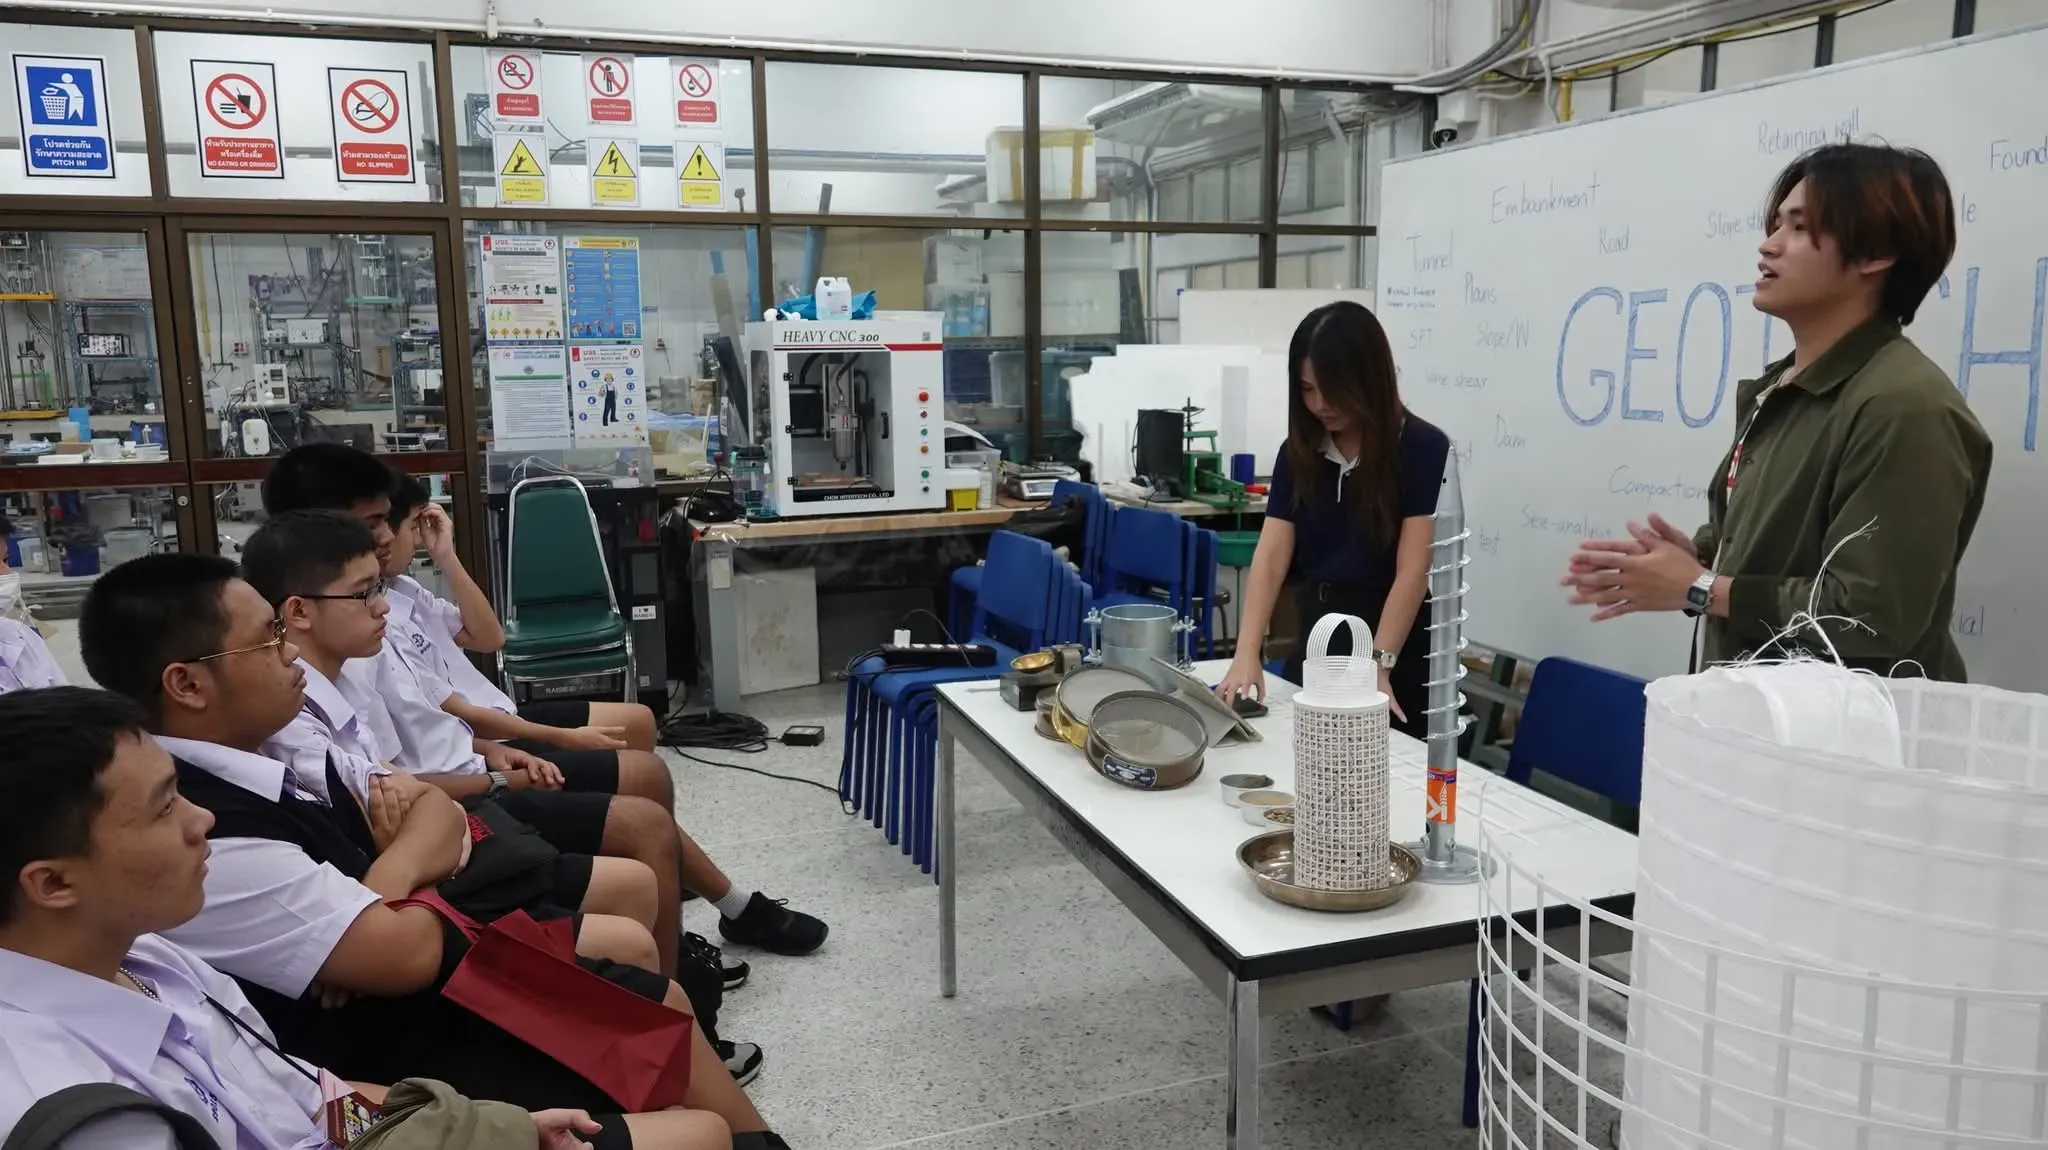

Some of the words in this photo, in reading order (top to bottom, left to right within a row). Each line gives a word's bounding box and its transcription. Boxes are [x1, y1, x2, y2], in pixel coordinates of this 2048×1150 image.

[1406, 230, 1454, 273] Tunnel
[783, 331, 829, 343] HEAVY
[829, 330, 857, 343] CNC
[859, 334, 880, 342] 300
